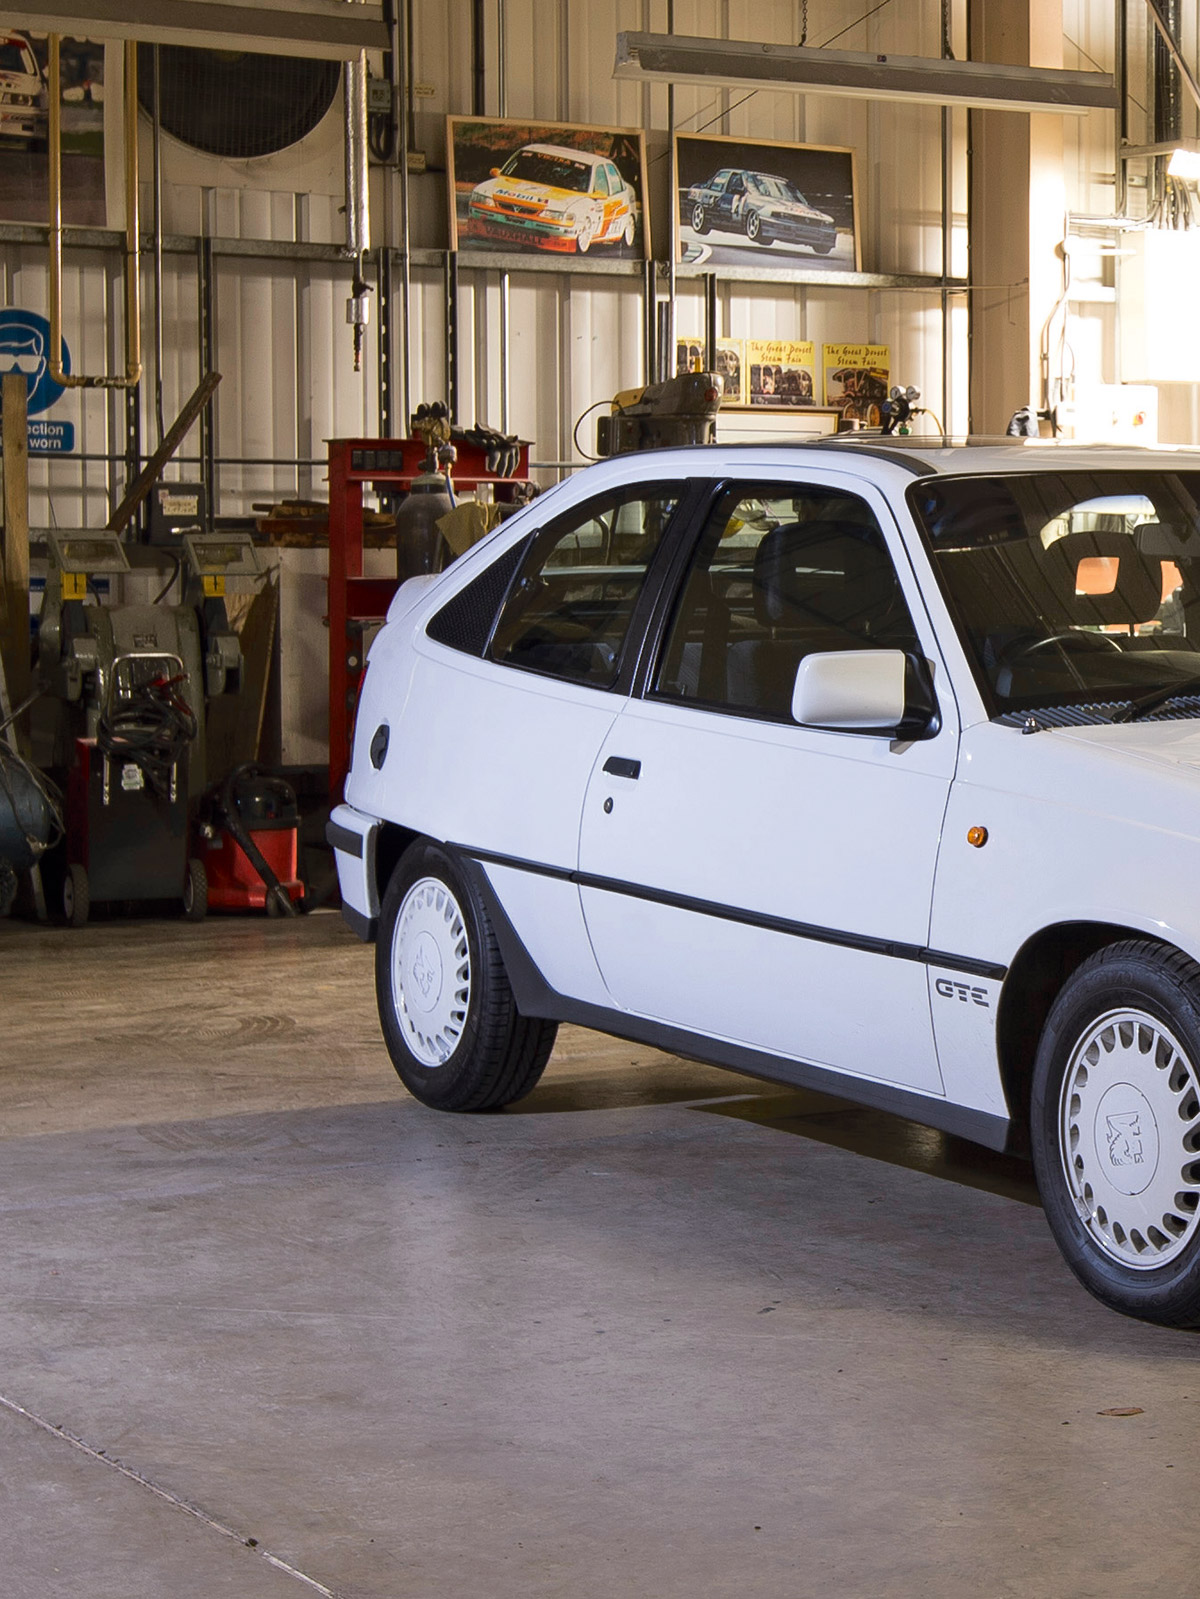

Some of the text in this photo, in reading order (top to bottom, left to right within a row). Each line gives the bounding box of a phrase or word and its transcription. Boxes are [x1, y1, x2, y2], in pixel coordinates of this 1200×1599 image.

[750, 342, 765, 351] The
[766, 342, 787, 353] Great
[826, 346, 840, 355] The
[842, 346, 862, 356] Great
[760, 354, 784, 363] Steam
[837, 357, 858, 366] Steam
[30, 438, 62, 449] worn
[935, 978, 990, 1008] GTE
